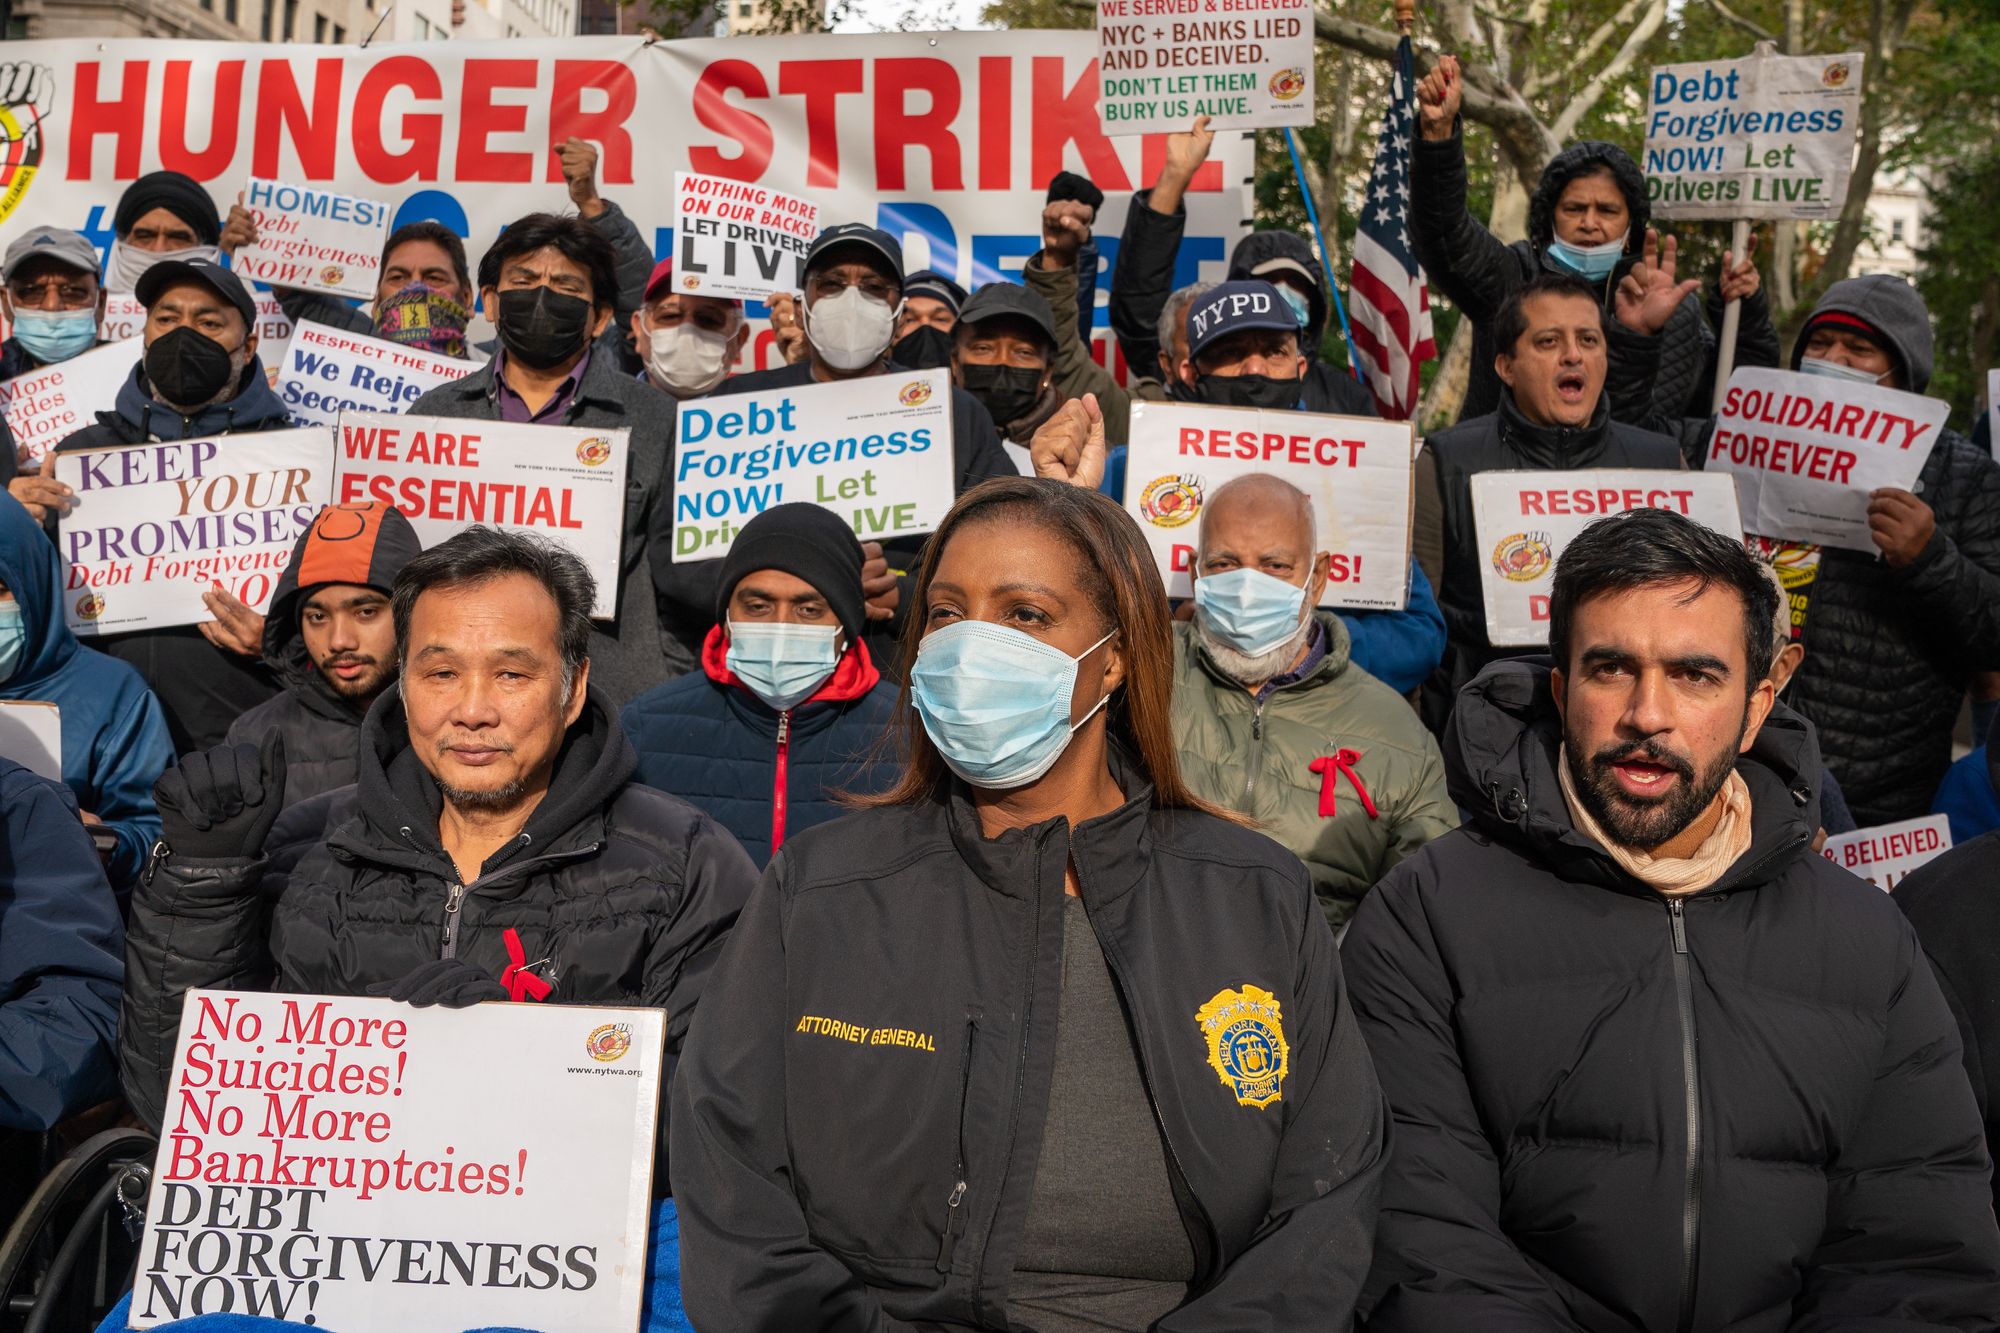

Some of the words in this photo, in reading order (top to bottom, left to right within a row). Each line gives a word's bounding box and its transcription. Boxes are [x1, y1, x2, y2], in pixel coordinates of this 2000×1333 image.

[1101, 0, 1128, 17] WE
[1133, 0, 1198, 15] SERVED
[1205, 0, 1217, 12] &
[1102, 25, 1145, 46] NYC
[1153, 28, 1165, 40] +
[1173, 20, 1247, 42] BANKS
[1254, 18, 1301, 39] LIED
[1102, 49, 1148, 70] AND
[1156, 44, 1269, 67] DECEIVED.
[1105, 77, 1162, 97] DON'T
[1168, 75, 1199, 94] LET
[1203, 73, 1257, 92] THEM
[1654, 68, 1739, 105] Debt
[66, 56, 637, 184] HUNGER
[1106, 101, 1157, 121] BURY
[1163, 100, 1189, 118] US
[1193, 97, 1252, 116] ALIVE.
[1650, 107, 1843, 142] Forgiveness
[1648, 147, 1724, 173] NOW!
[1745, 143, 1796, 168] Let
[250, 182, 385, 228] HOMES!
[682, 177, 767, 205] NOTHING
[772, 195, 817, 220] MORE
[1646, 176, 1740, 201] Drivers
[1753, 177, 1831, 202] LIVE.
[250, 209, 299, 234] Debt
[682, 197, 711, 215] ON
[717, 203, 755, 222] OUR
[760, 211, 817, 239] BACKS!
[683, 217, 720, 237] LET
[728, 223, 813, 255] DRIVERS
[235, 255, 313, 285] NOW!
[258, 231, 379, 269] orgiveness
[98, 322, 132, 340] YC
[1192, 293, 1271, 339] NYPD
[303, 330, 386, 359] RESPECT
[392, 352, 428, 372] THE
[0, 371, 64, 404] More
[294, 349, 340, 381] We
[350, 364, 422, 403] Reje
[3, 393, 65, 426] cides
[9, 410, 76, 440] More
[681, 398, 796, 444] Debt
[1722, 387, 1932, 450] SOLIDARITY
[76, 442, 217, 492] KEEP
[343, 426, 400, 461] WE
[405, 431, 481, 468] ARE
[678, 428, 932, 482] Forgiveness
[1179, 427, 1366, 468] RESPECT
[1711, 430, 1857, 485] FOREVER
[175, 468, 311, 516] YOUR
[341, 472, 583, 529] ESSENTIAL
[678, 483, 783, 522] NOW!
[816, 469, 876, 503] Let
[1520, 489, 1693, 516] RESPECT
[67, 504, 328, 565] PROMISES
[854, 503, 928, 536] IVE.
[67, 561, 134, 590] Debt
[143, 549, 294, 583] Forgivene
[1844, 828, 1946, 867] BELIEVED.
[191, 996, 262, 1044] No
[276, 1001, 407, 1049] More
[796, 1015, 870, 1044] ATTORNEY
[870, 1027, 936, 1051] GENERAL
[1219, 1041, 1231, 1066] NEW
[1226, 1020, 1256, 1035] YORK
[1261, 1025, 1281, 1060] STATE
[181, 1043, 407, 1097] Suicides!
[567, 1067, 643, 1077] www.nytwa.org
[1239, 1075, 1277, 1090] ATTORNEY
[1242, 1085, 1277, 1098] GENERAL
[172, 1089, 243, 1136] No
[258, 1094, 391, 1143] More
[162, 1134, 527, 1201] Bankruptcies!
[155, 1182, 325, 1232] DEBT
[148, 1228, 598, 1292] FORGIVENESS
[140, 1274, 320, 1325] NOW!
